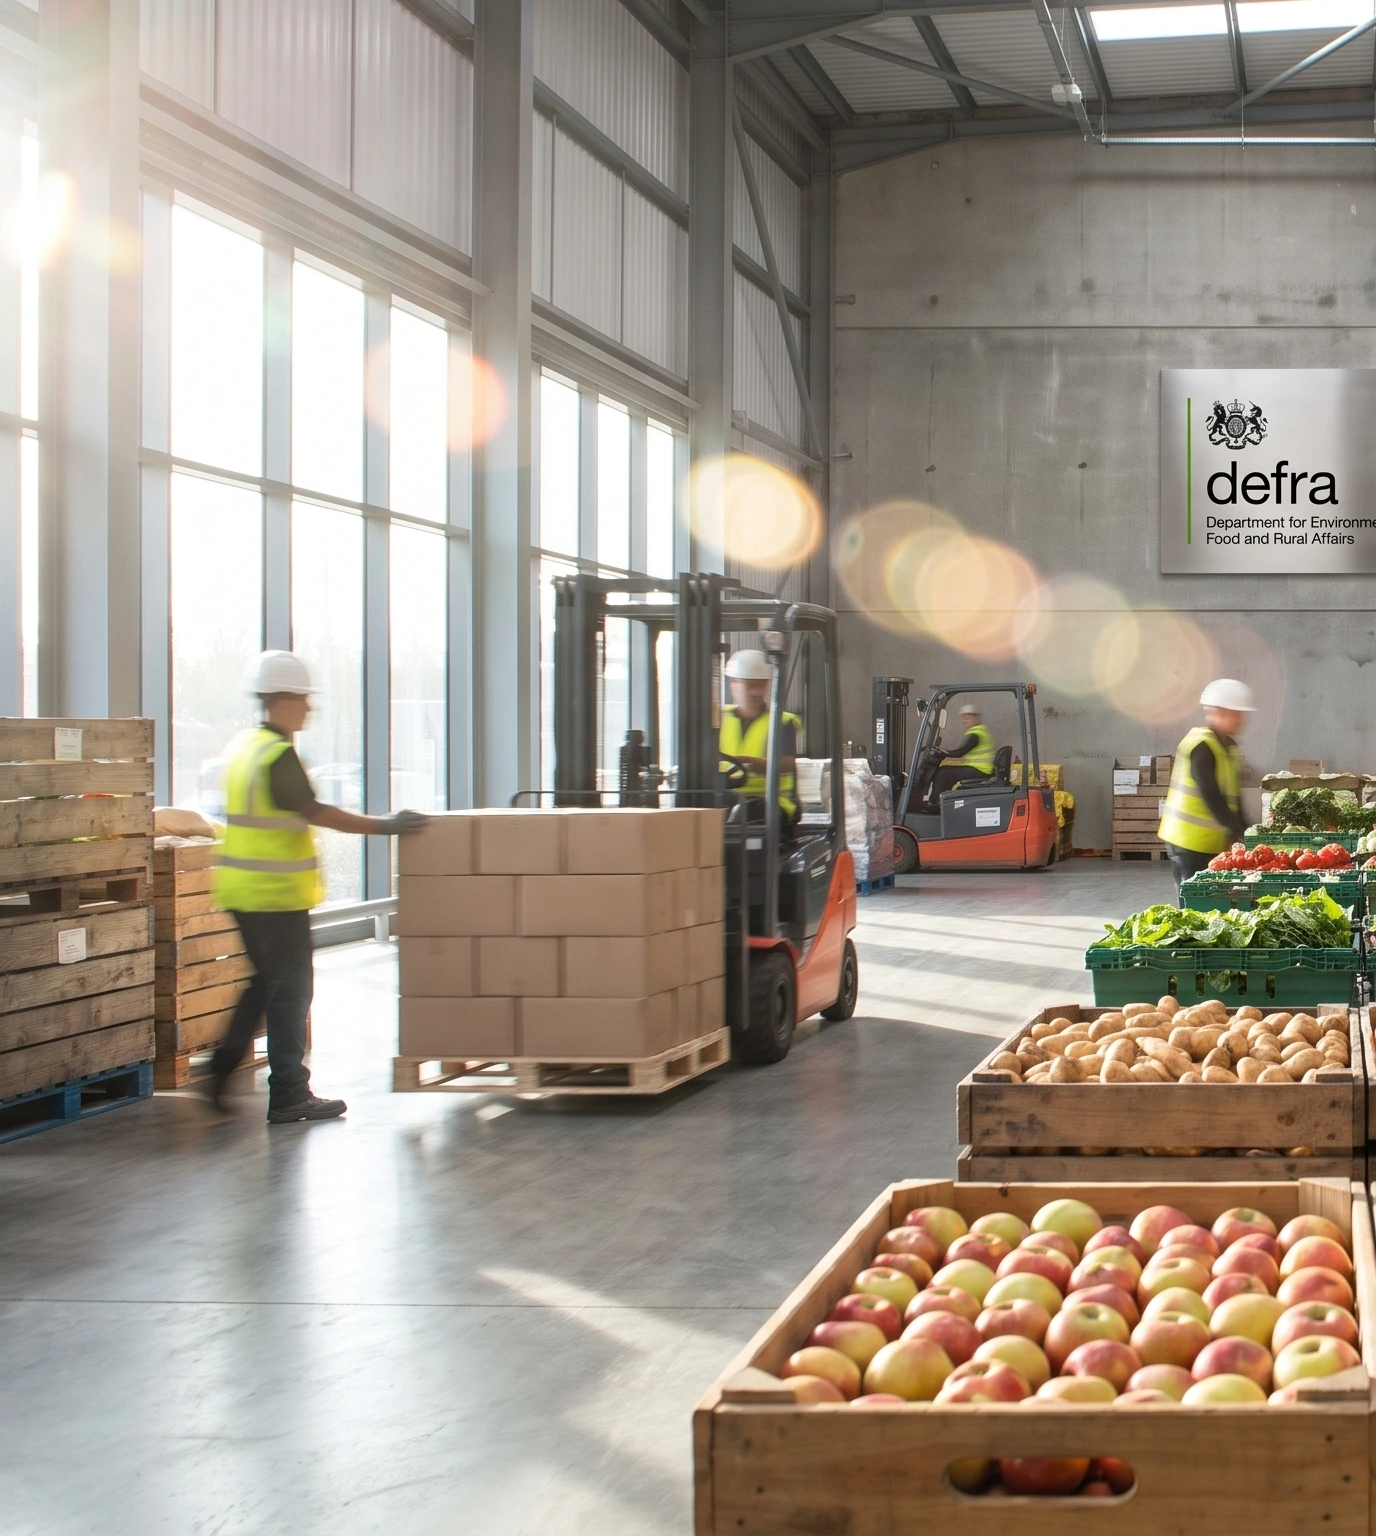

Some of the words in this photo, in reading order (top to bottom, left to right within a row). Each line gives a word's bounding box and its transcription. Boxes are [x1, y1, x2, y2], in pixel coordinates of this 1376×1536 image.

[1206, 460, 1339, 505] defra
[1206, 516, 1285, 531] Department
[1288, 516, 1308, 529] for
[1206, 532, 1240, 545] Food
[1244, 532, 1269, 545] and
[1273, 532, 1308, 545] Rural
[1311, 532, 1355, 545] Affairs
